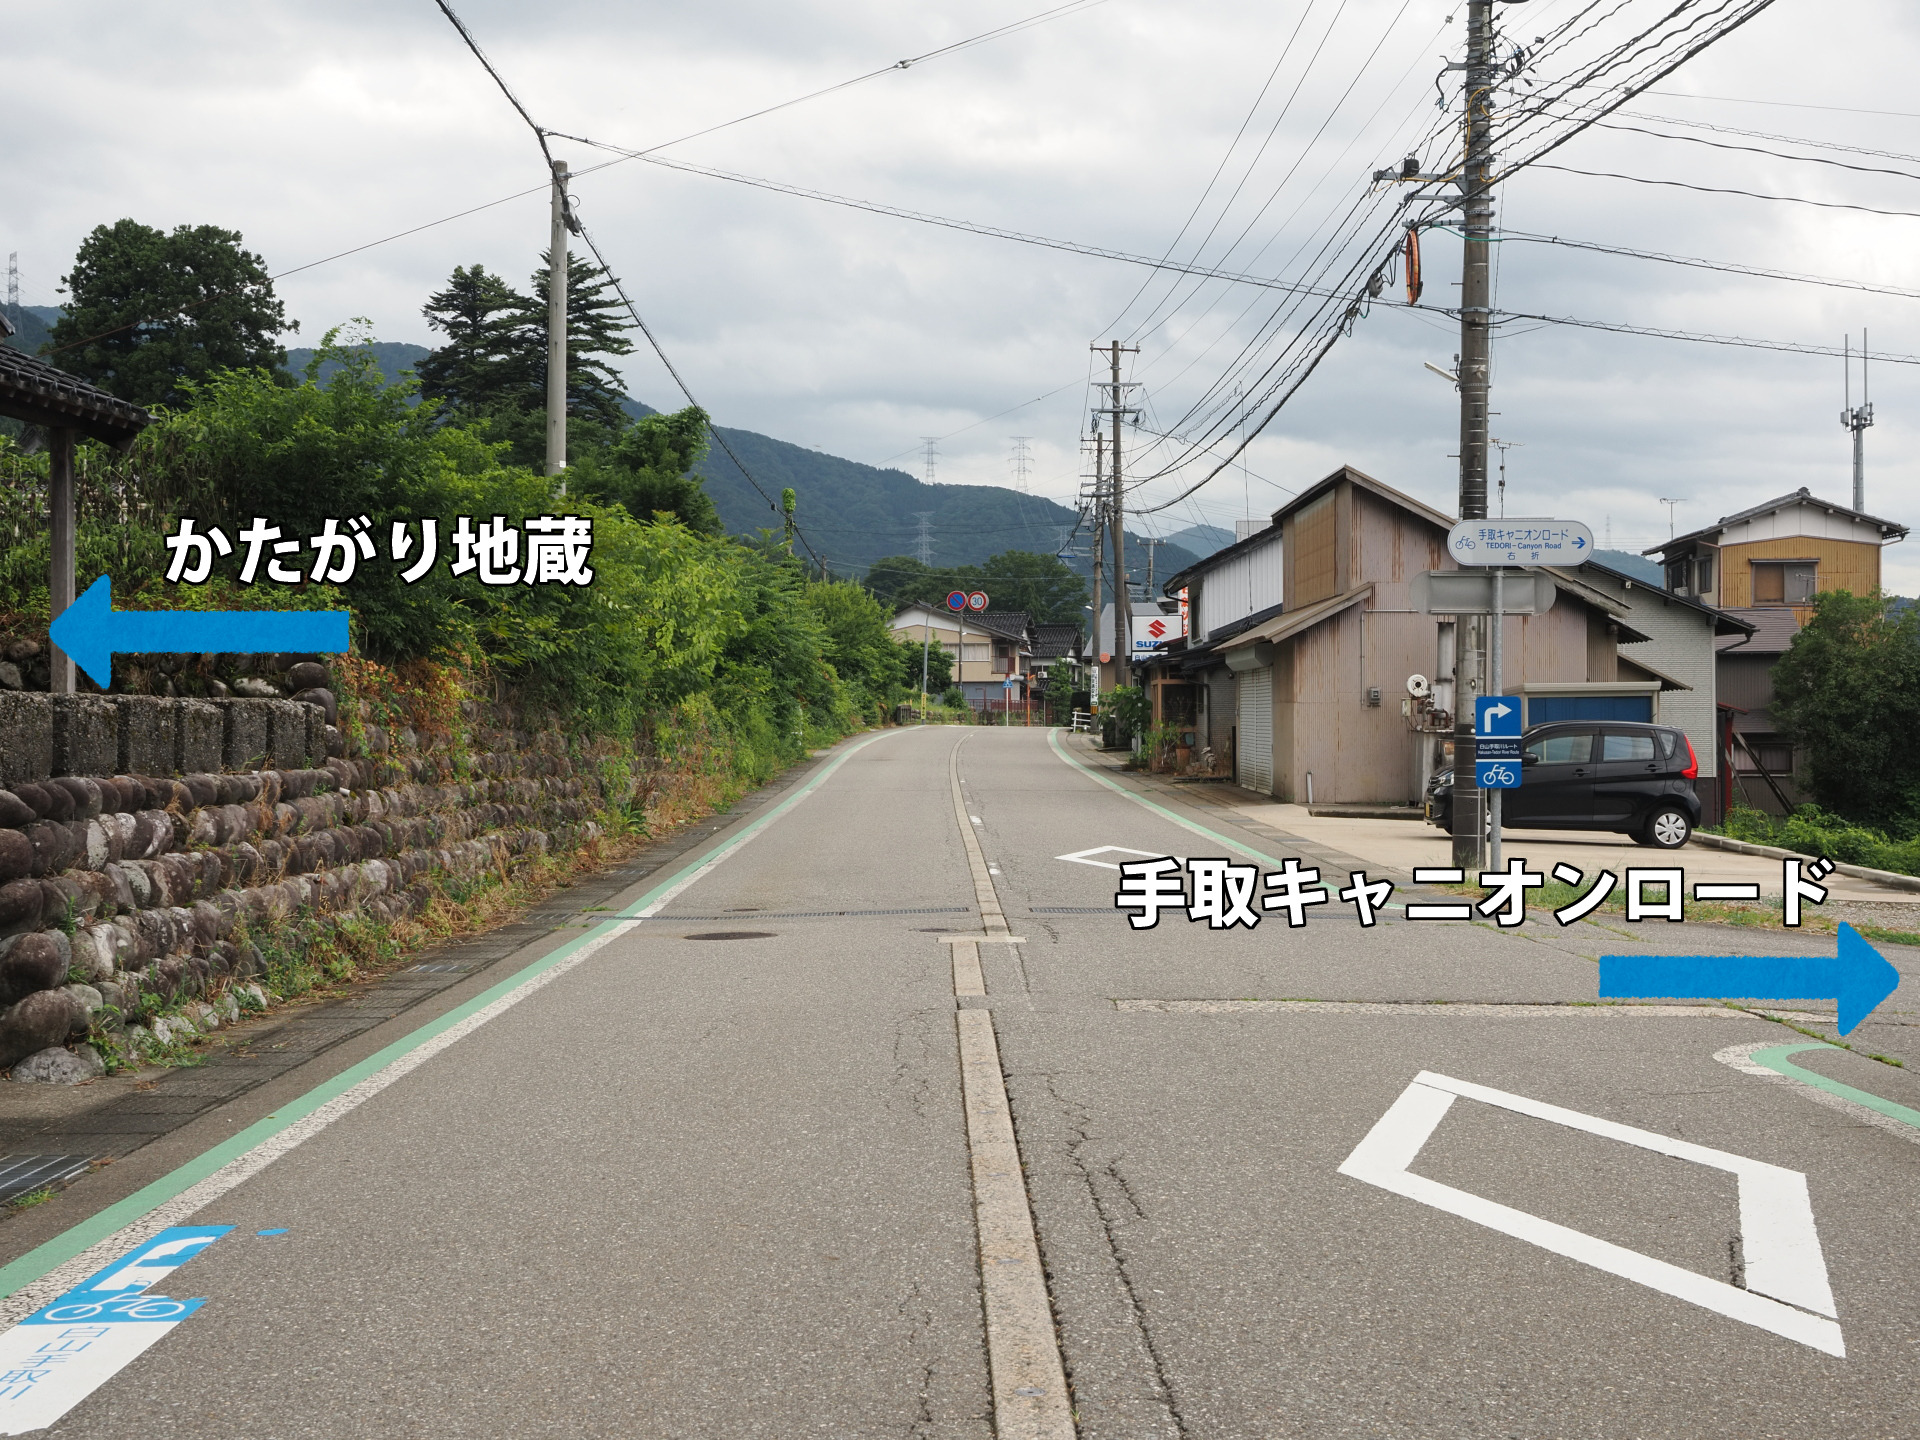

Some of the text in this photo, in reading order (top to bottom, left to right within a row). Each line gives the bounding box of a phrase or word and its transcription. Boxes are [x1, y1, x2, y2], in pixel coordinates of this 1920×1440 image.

[1478, 528, 1569, 541] 手取キャニオンロード
[972, 597, 982, 606] 30
